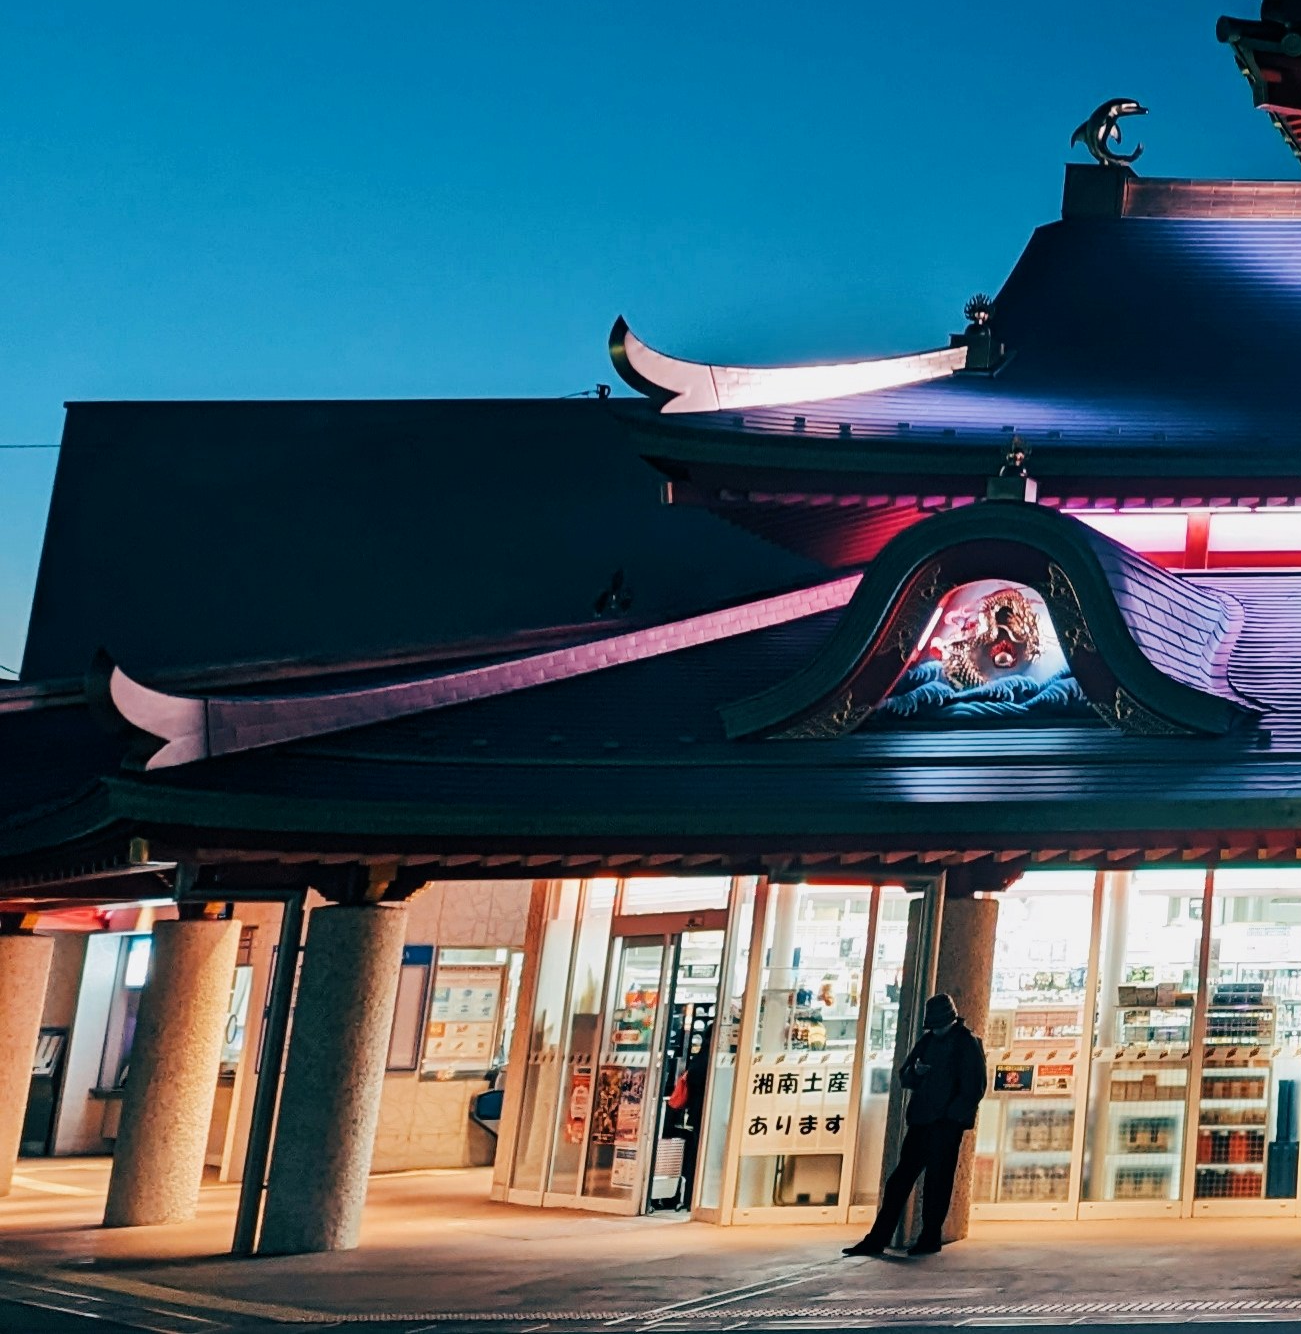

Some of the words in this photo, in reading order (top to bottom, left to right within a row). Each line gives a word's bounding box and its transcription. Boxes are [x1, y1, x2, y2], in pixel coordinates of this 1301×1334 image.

[752, 1071, 849, 1095] 湘南土産
[748, 1114, 845, 1136] あります
